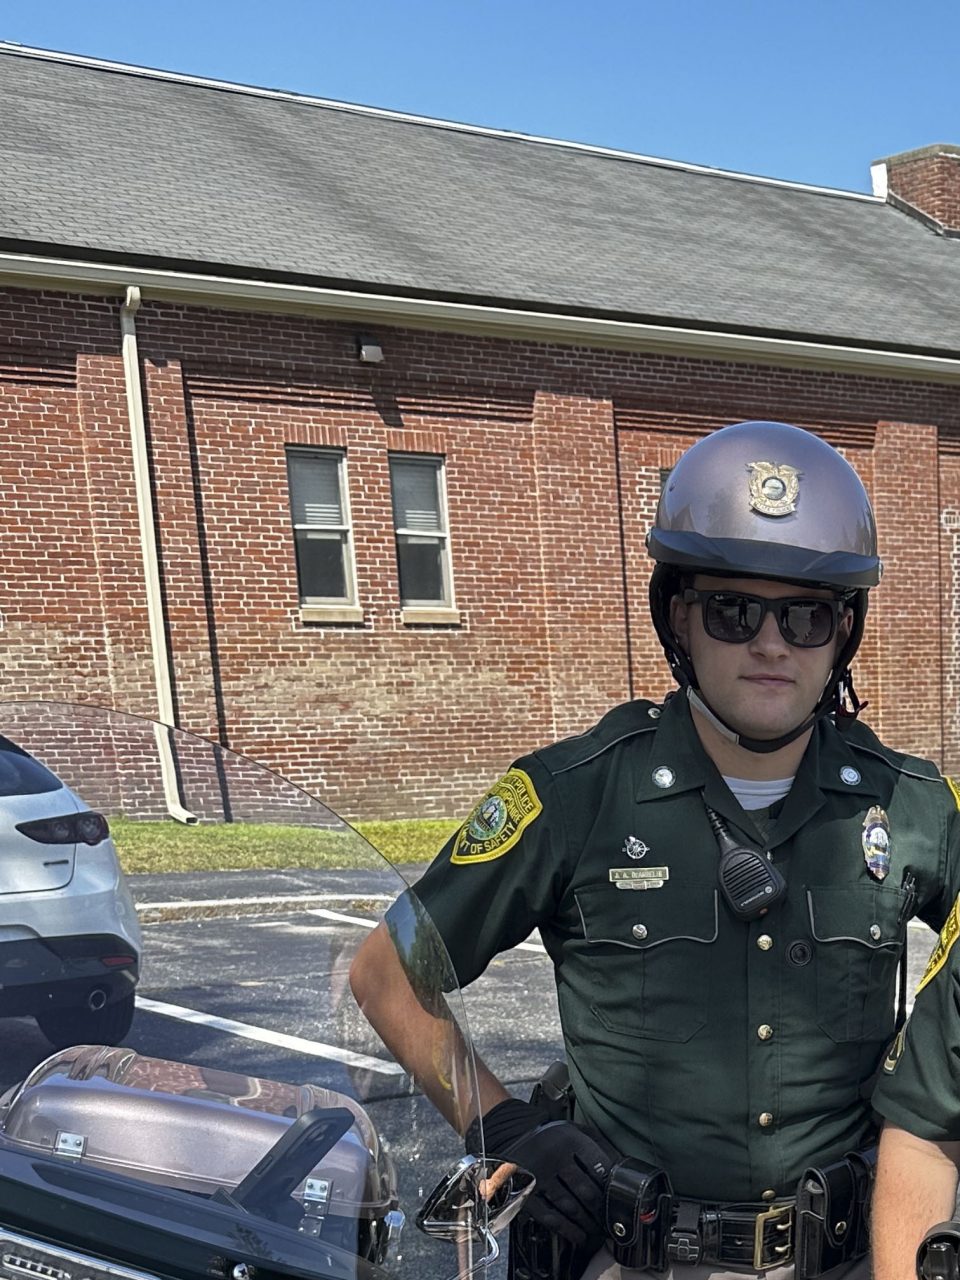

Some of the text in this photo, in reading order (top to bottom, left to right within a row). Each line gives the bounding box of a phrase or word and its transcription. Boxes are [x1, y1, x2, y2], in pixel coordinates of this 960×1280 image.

[515, 778, 534, 813] POLICE
[470, 843, 484, 854] OF
[484, 821, 516, 852] SAFETY
